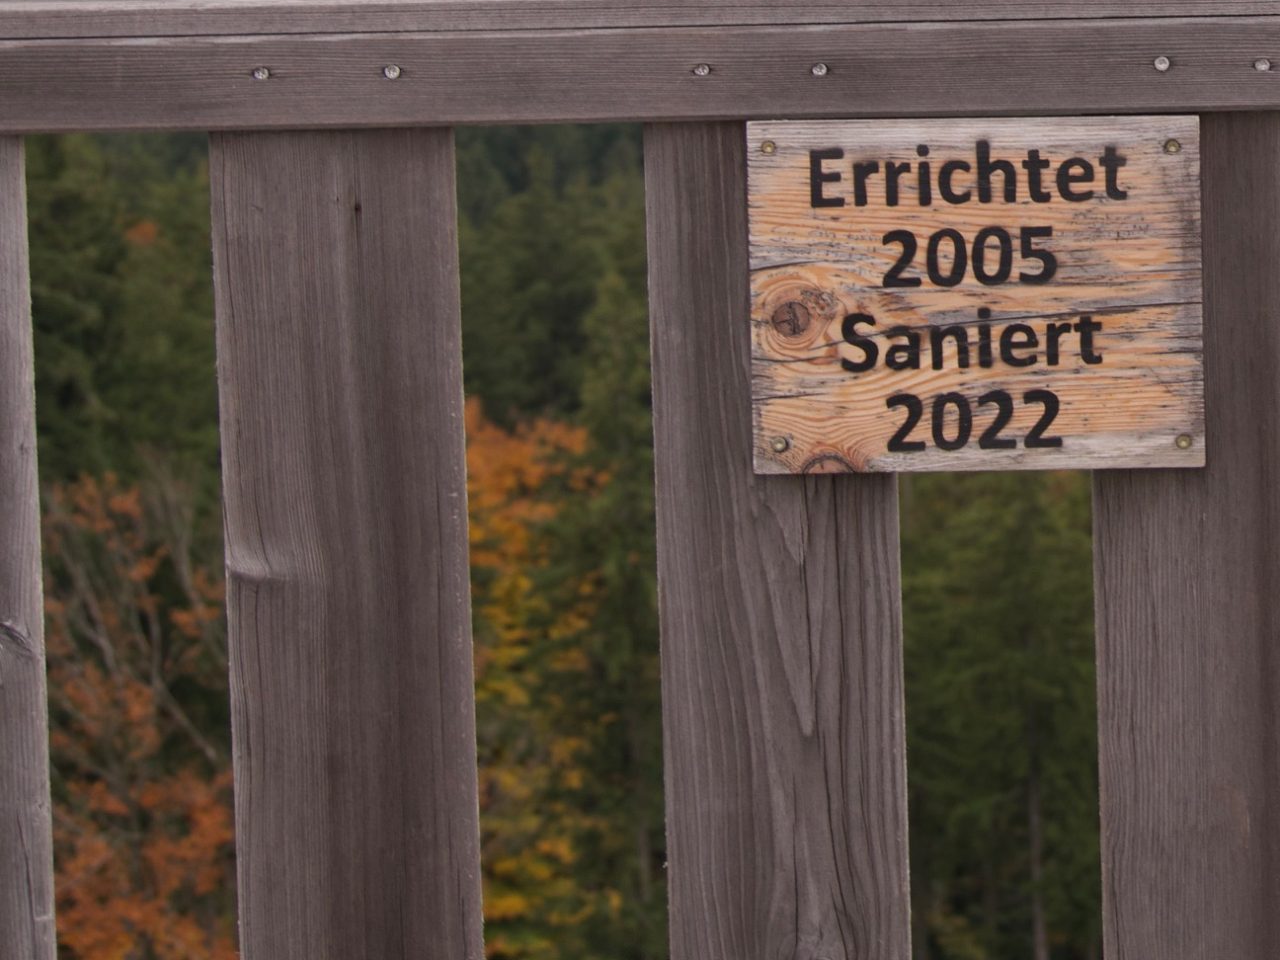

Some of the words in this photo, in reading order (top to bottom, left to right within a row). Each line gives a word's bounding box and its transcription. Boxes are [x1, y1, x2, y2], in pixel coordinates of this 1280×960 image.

[809, 139, 1128, 209] Errichtet
[881, 225, 1059, 289] 2005
[840, 307, 1103, 374] Saniert
[886, 388, 1063, 453] 2022
